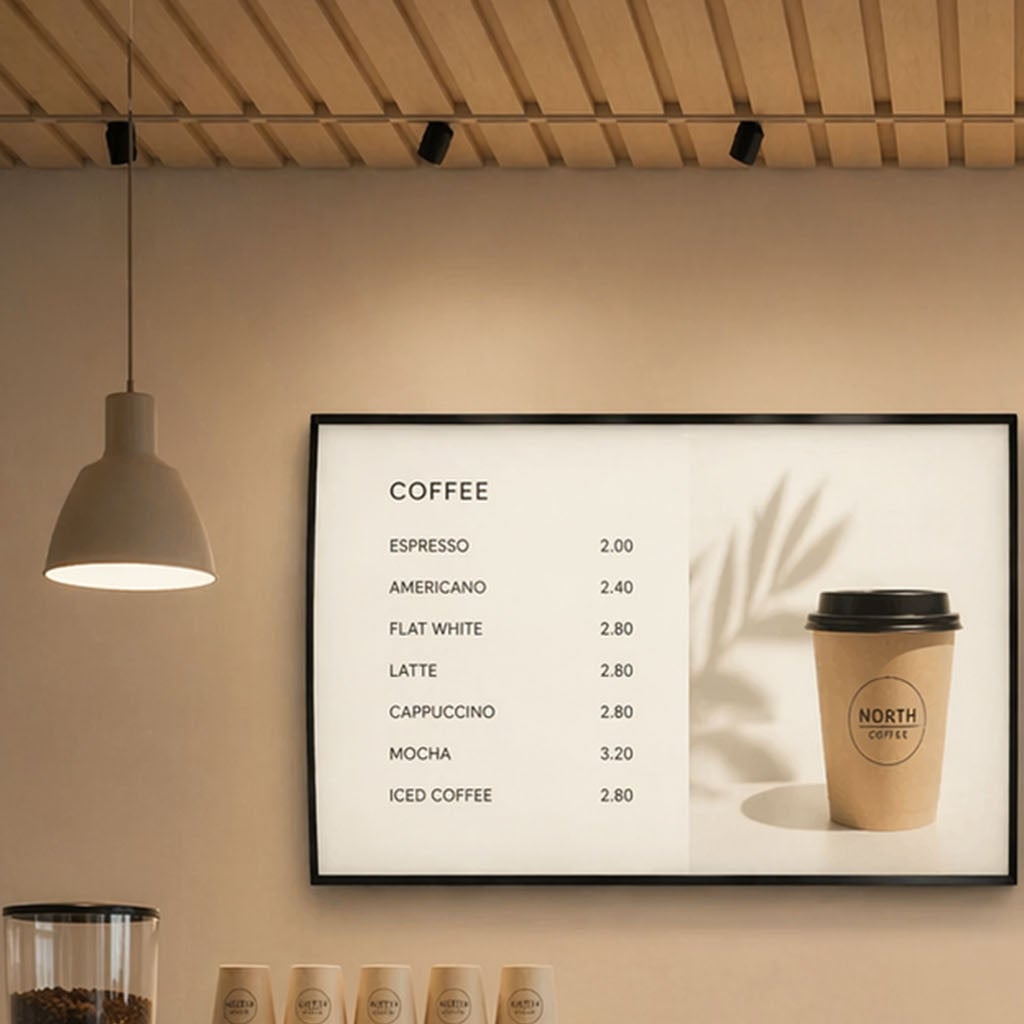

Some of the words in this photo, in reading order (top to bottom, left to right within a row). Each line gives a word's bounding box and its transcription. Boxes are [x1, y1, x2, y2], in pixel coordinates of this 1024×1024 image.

[389, 480, 489, 502] COFFEE
[389, 538, 470, 554] ESPRESSO
[600, 538, 634, 554] 2.00
[388, 579, 487, 595] AMERICANO
[600, 579, 634, 595] 2.40
[389, 621, 428, 637] FLAT
[431, 621, 483, 636] WHITE
[600, 621, 634, 637] 2.80
[389, 663, 438, 678] LATTE
[600, 662, 634, 678] 2.80
[388, 704, 496, 720] CAPPUCCINO
[600, 704, 634, 720] 2.80
[858, 707, 918, 724] NORTH
[389, 746, 452, 762] MOCHA
[600, 746, 634, 761] 3.20
[389, 787, 427, 803] ICED
[430, 787, 493, 803] COFFEE
[600, 787, 634, 803] 2.80
